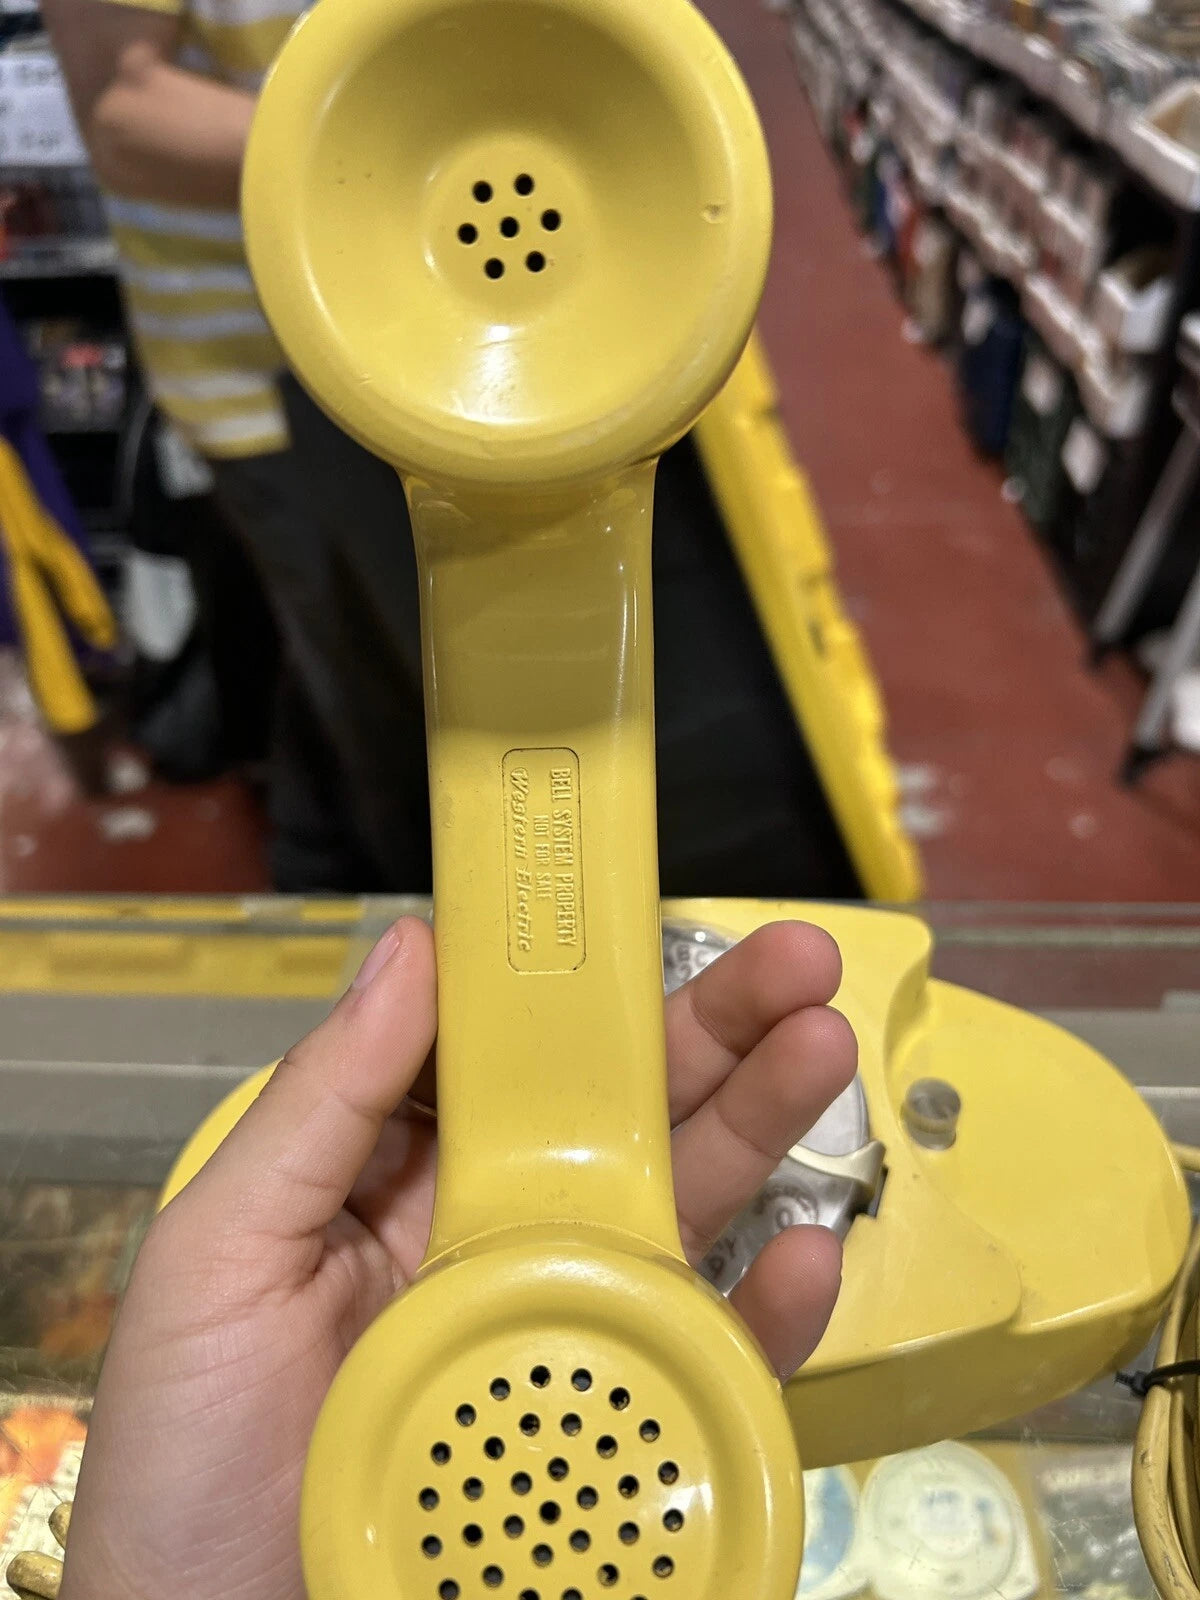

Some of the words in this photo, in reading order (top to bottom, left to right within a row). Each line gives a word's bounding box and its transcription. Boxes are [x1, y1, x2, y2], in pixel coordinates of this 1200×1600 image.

[551, 768, 572, 802] BELL
[510, 767, 529, 859] Western
[534, 815, 549, 836] NOT
[535, 844, 550, 864] FOR
[553, 809, 573, 864] SYSTEM
[536, 873, 551, 899] SALE
[515, 867, 533, 951] Electric
[556, 873, 576, 946] PROPERTY
